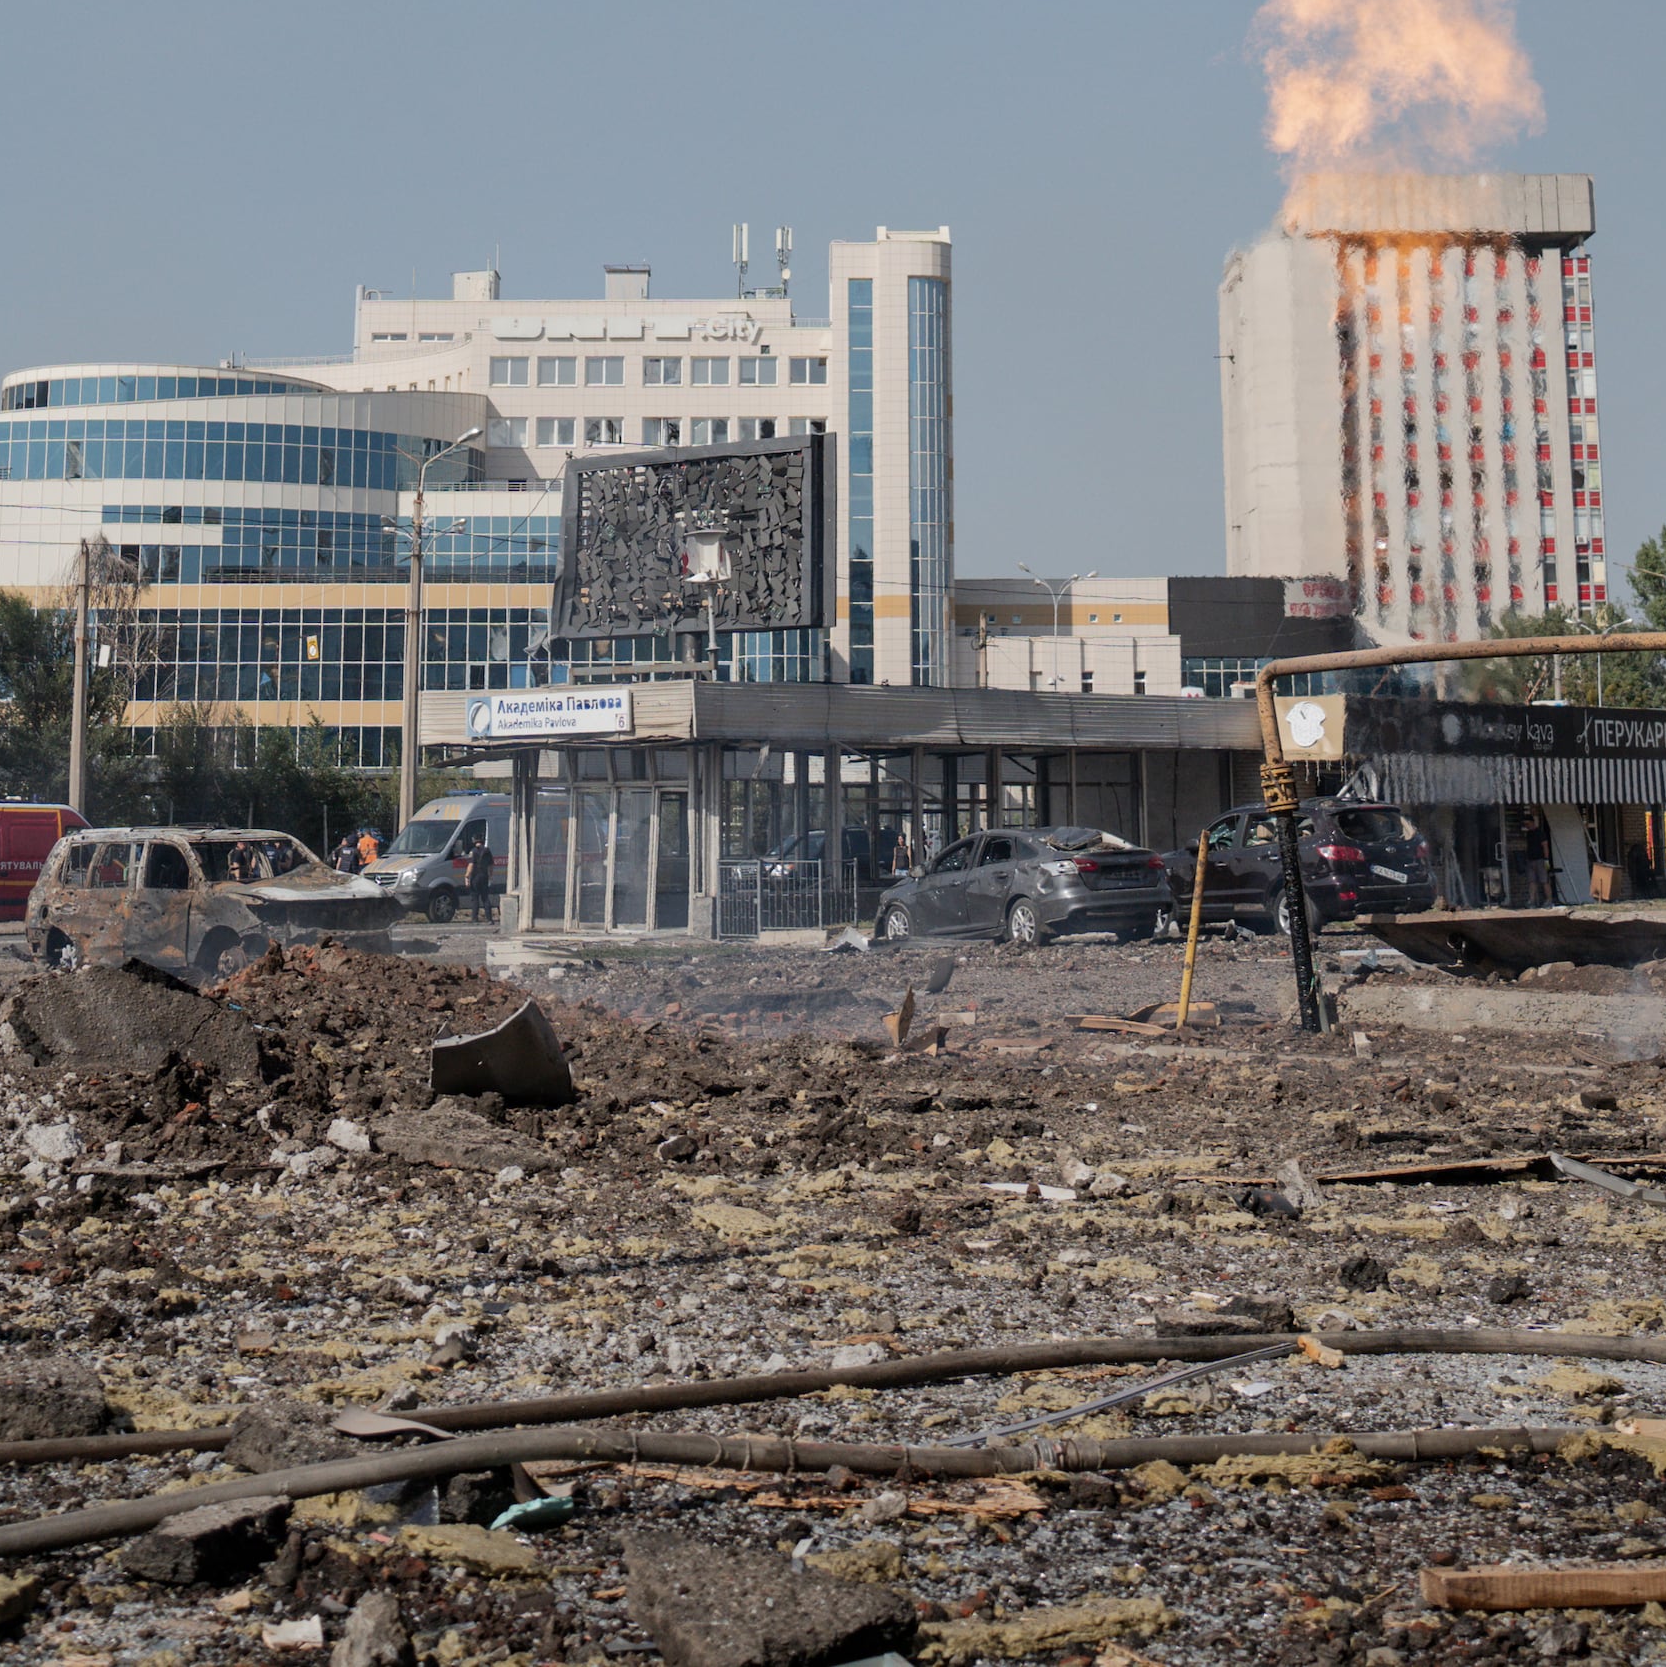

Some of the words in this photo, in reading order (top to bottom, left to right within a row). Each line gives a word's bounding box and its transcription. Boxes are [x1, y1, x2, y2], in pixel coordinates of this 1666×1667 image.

[497, 696, 563, 716] Академіка
[566, 696, 622, 711] Павлова
[497, 716, 543, 730] Akademika
[545, 716, 577, 729] Pavlova
[1526, 713, 1554, 744] kava
